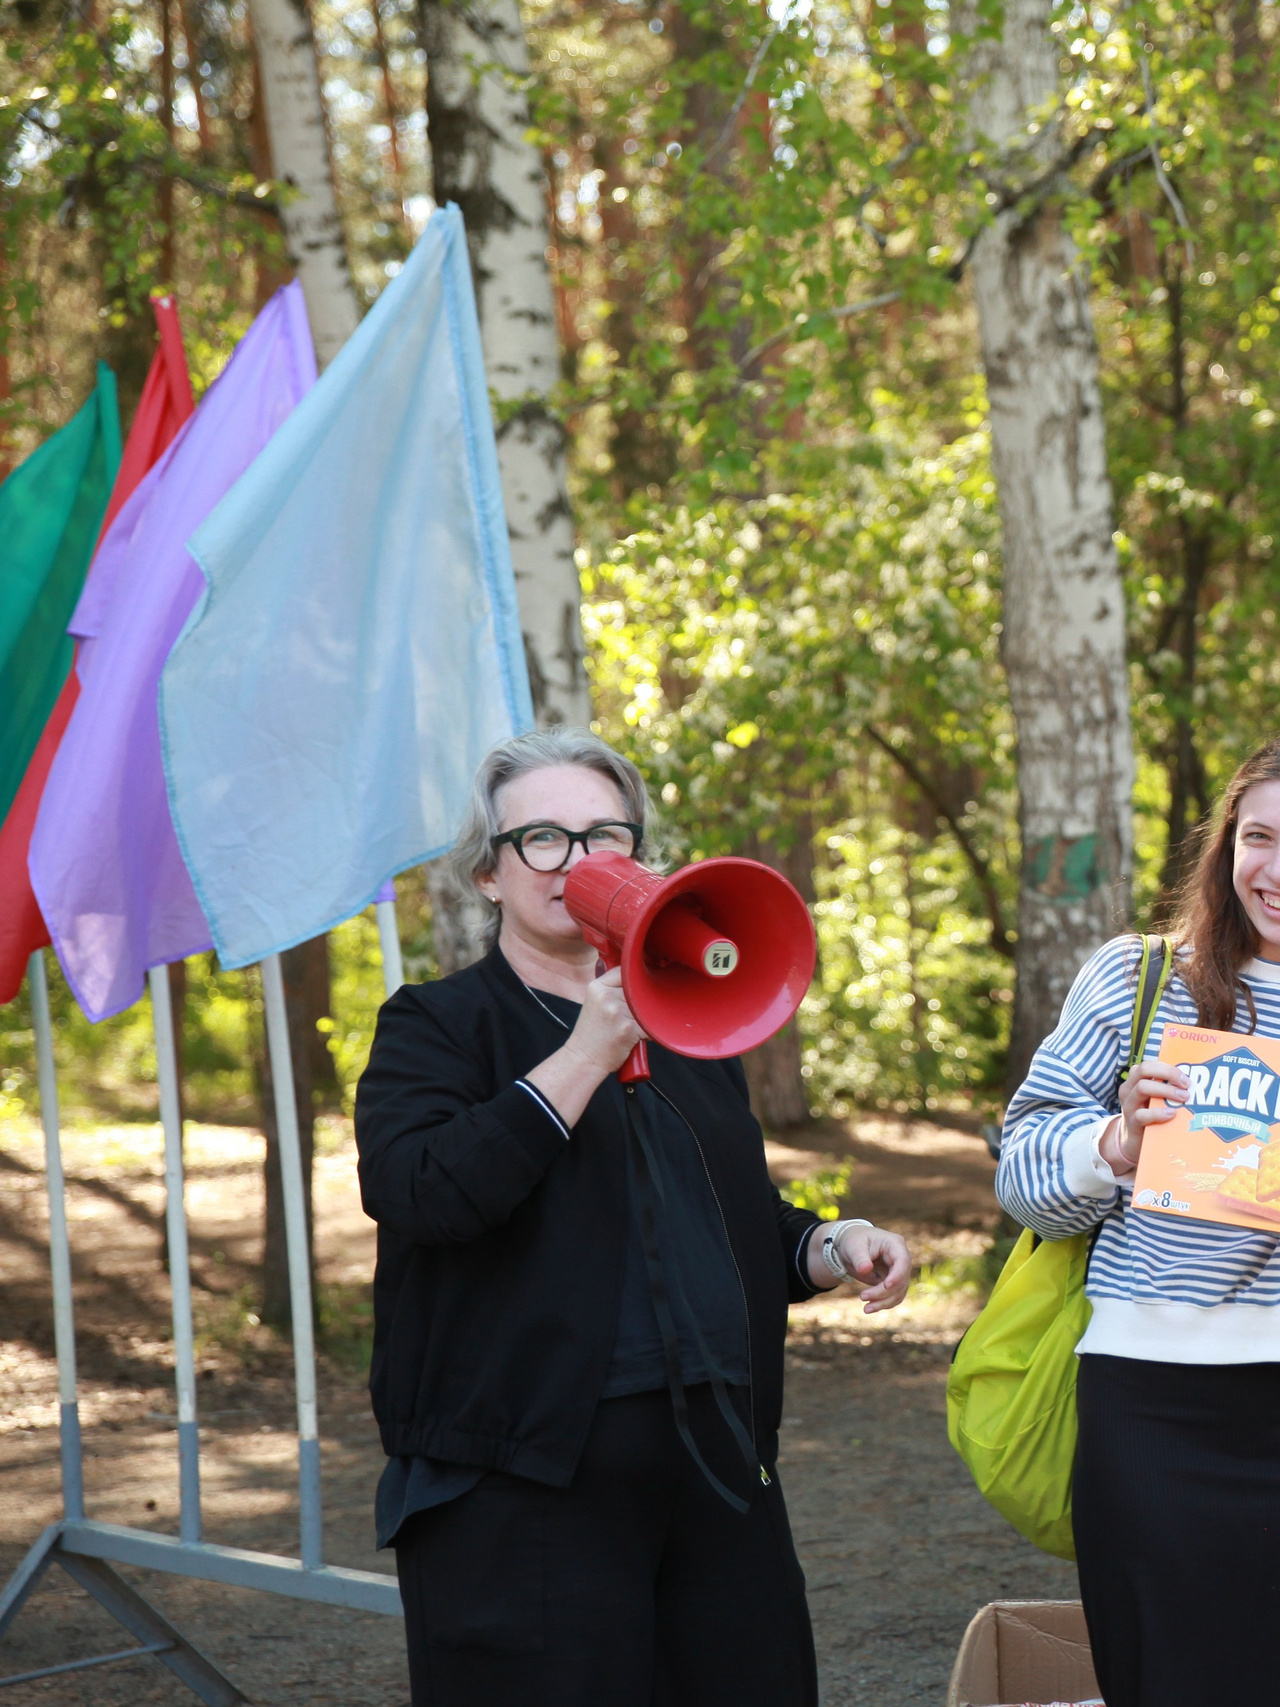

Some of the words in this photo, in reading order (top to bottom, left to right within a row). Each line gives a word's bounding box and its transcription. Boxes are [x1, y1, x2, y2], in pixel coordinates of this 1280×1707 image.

[1180, 1029, 1218, 1044] ORION
[1222, 1055, 1238, 1063] SOFT
[1237, 1057, 1260, 1067] BISCUIT
[1201, 1113, 1262, 1134] СЛИВОЧНЫЙ
